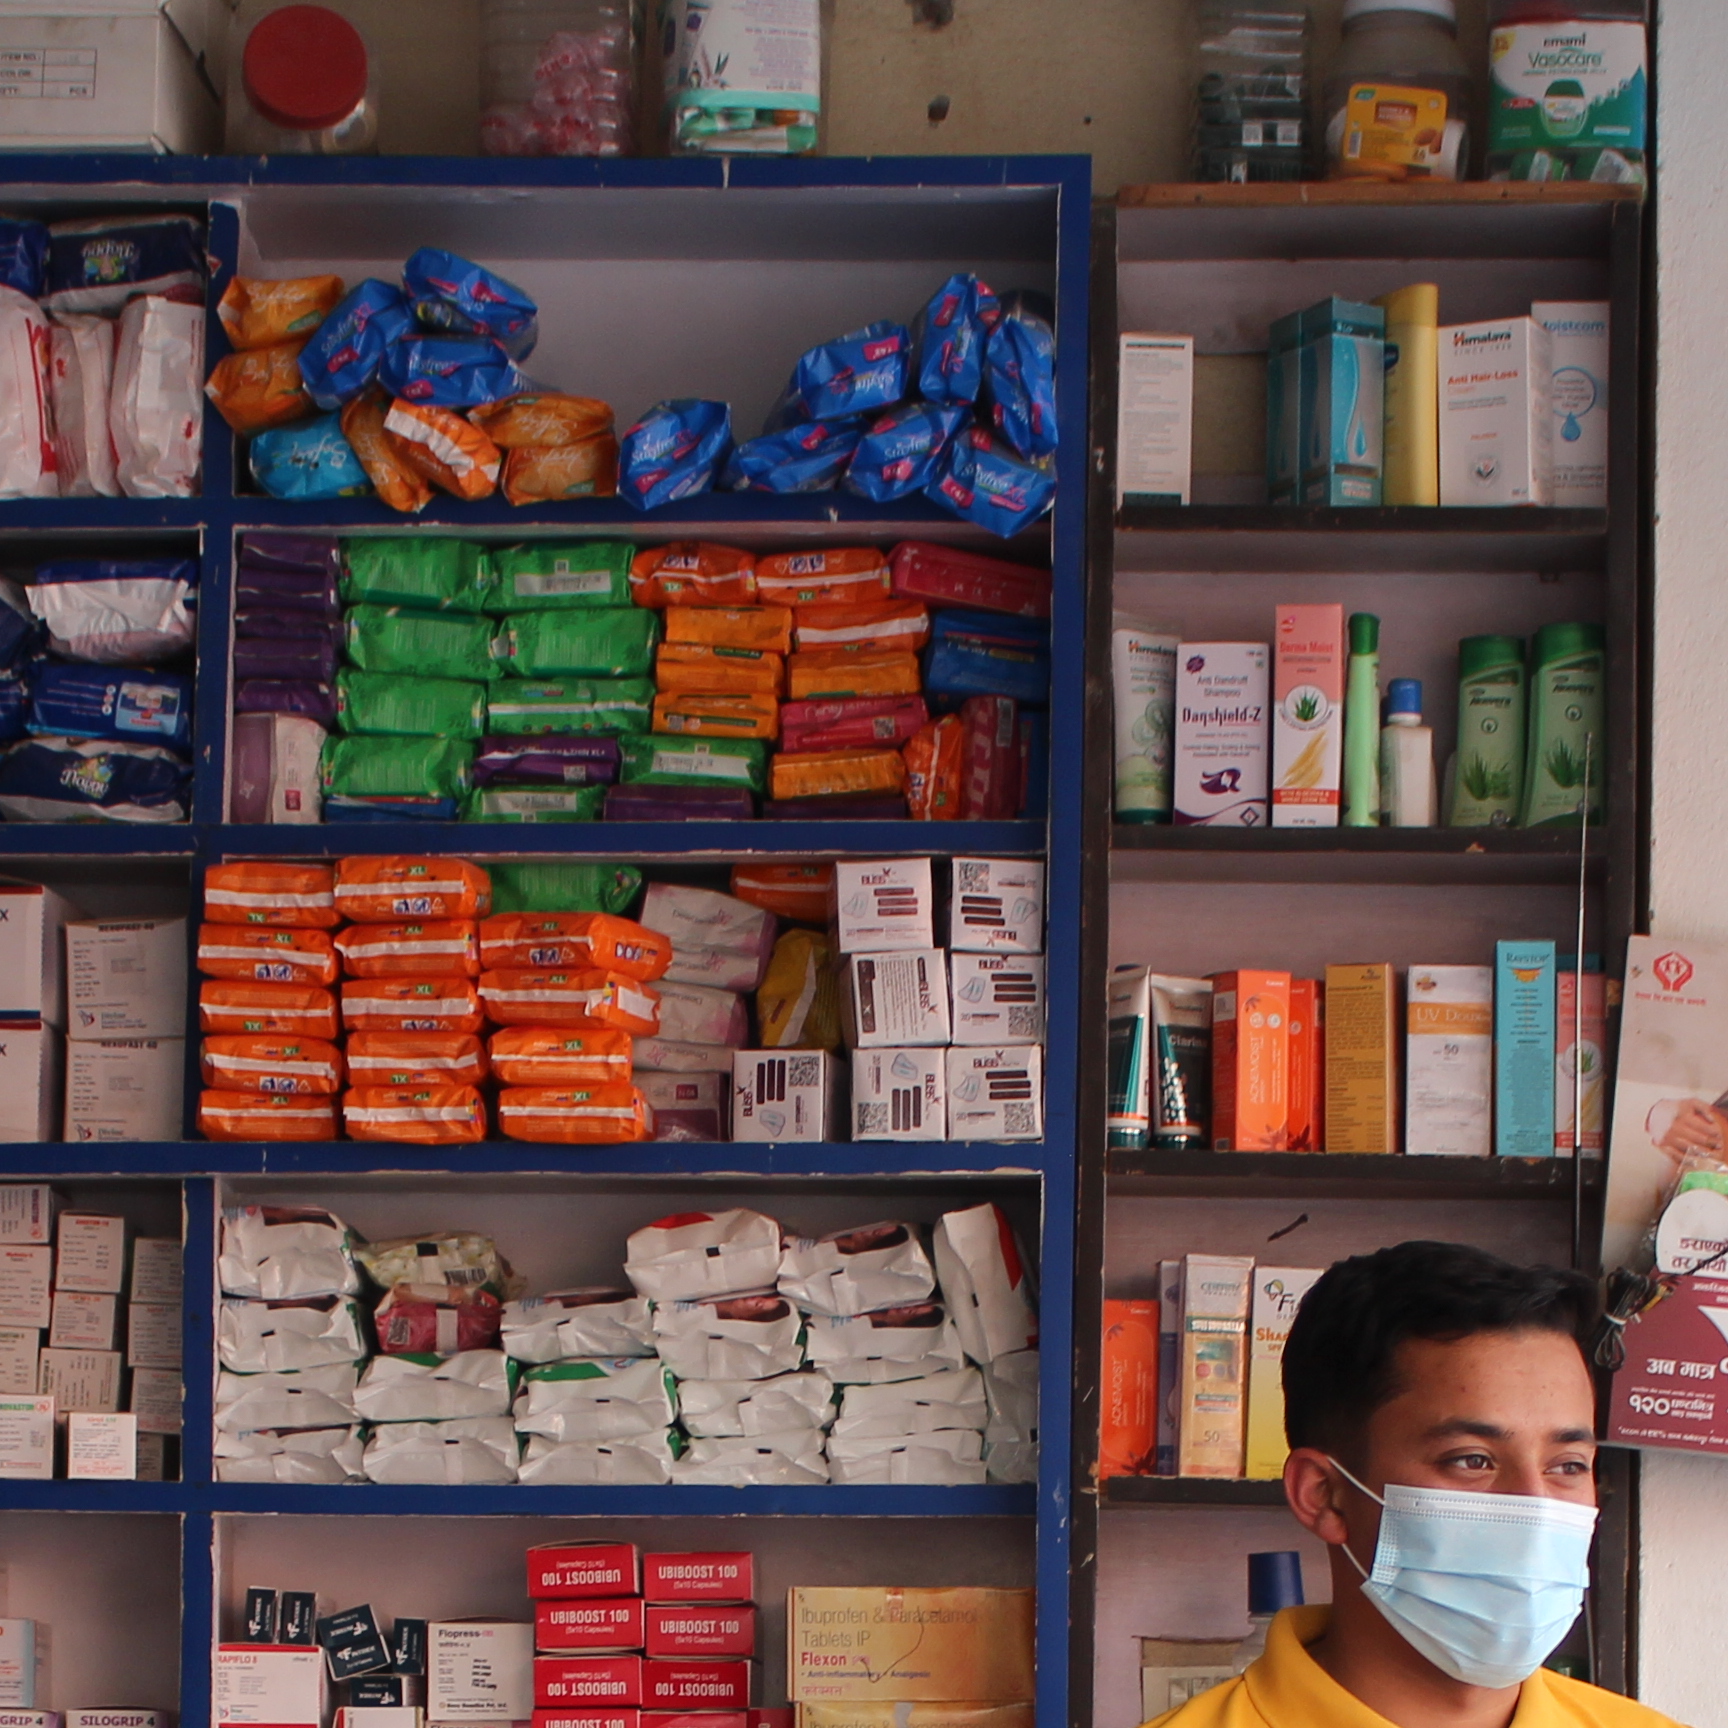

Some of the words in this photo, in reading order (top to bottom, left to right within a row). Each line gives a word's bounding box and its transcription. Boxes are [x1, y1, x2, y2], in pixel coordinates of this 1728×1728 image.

[1417, 1007, 1441, 1021] UV
[657, 1565, 715, 1580] UBIBOOST
[717, 1564, 738, 1579] 100
[549, 1609, 607, 1626] UBIBOOST
[609, 1608, 630, 1623] 100
[800, 1607, 869, 1628] Ibuprofen
[872, 1608, 885, 1623] &
[801, 1629, 853, 1648] Tablets
[855, 1630, 871, 1647] IP
[800, 1652, 847, 1667] Flexon
